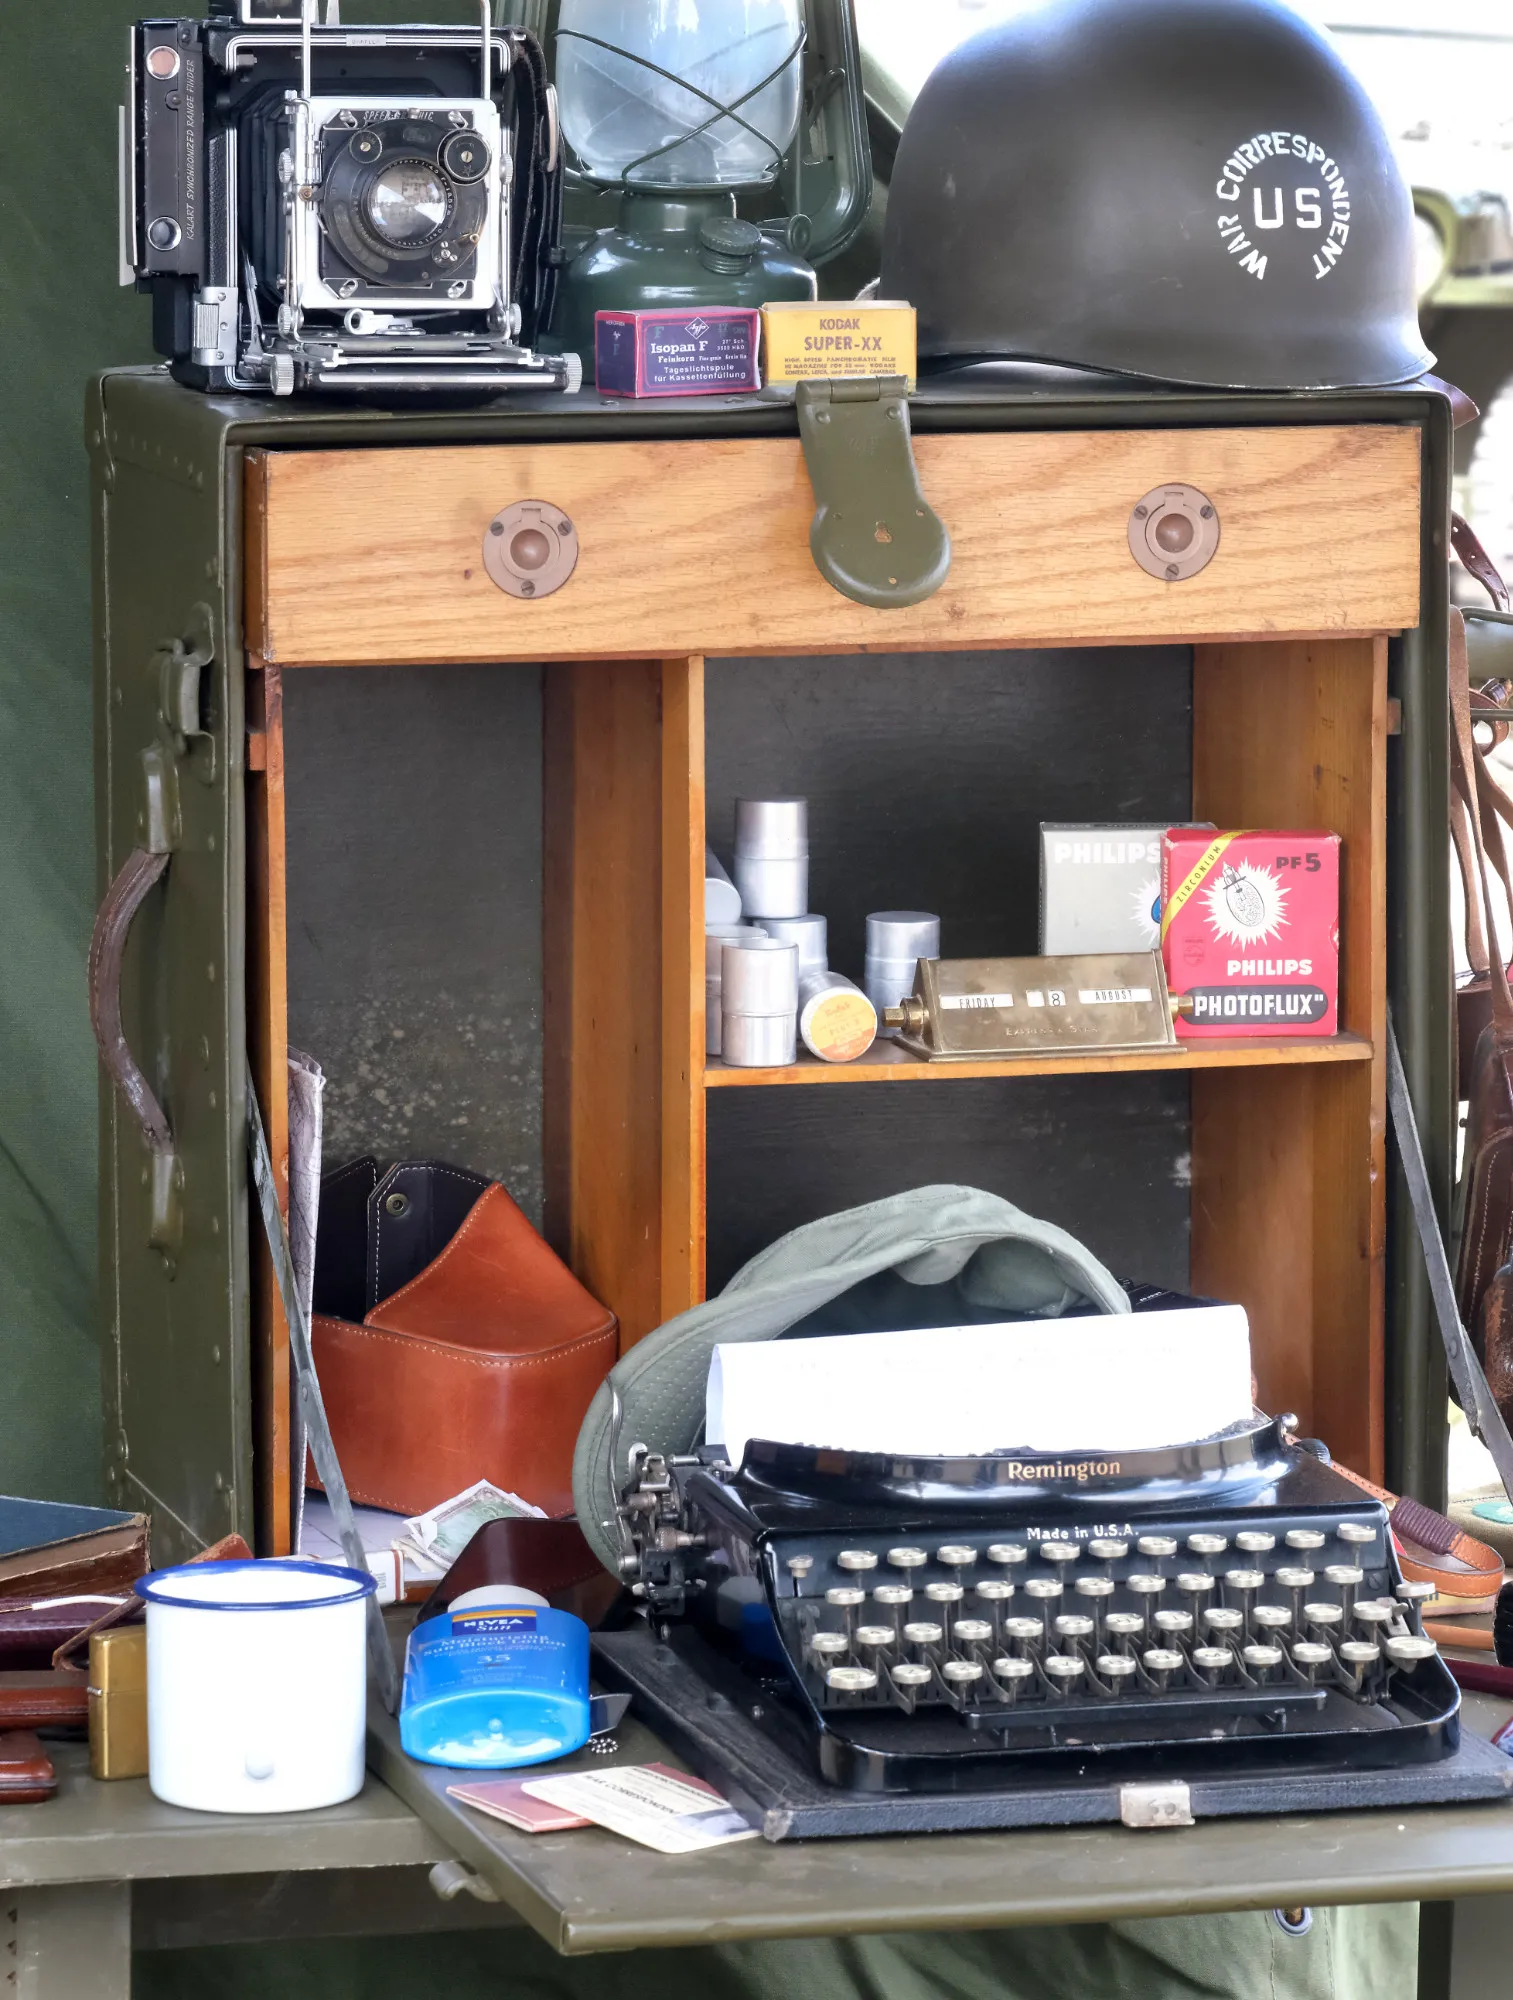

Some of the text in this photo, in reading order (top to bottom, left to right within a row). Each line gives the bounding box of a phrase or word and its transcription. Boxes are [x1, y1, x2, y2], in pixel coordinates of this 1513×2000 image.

[186, 60, 195, 240] KALART SYNCHRONIZED RANGE FINDER
[1216, 131, 1351, 280] WAR CORRESPONDENT
[819, 318, 861, 331] KODAK
[650, 341, 709, 355] Isopan F
[804, 336, 883, 351] SUPER-XX
[658, 355, 695, 363] Feinkorn
[664, 364, 735, 375] Tageslichtspule
[669, 372, 747, 382] Kassettenfüllung
[1053, 842, 1161, 865] PHILIPS
[1175, 845, 1221, 903] ZIRCONIUM
[1227, 959, 1313, 976] PHILIPS
[959, 989, 1133, 1009] FRIDAY 8 AUGUST
[1008, 1460, 1121, 1481] Remington
[1027, 1523, 1139, 1540] Made in U.S.A.
[464, 1618, 524, 1627] NIVEA
[477, 1654, 510, 1664] 35
